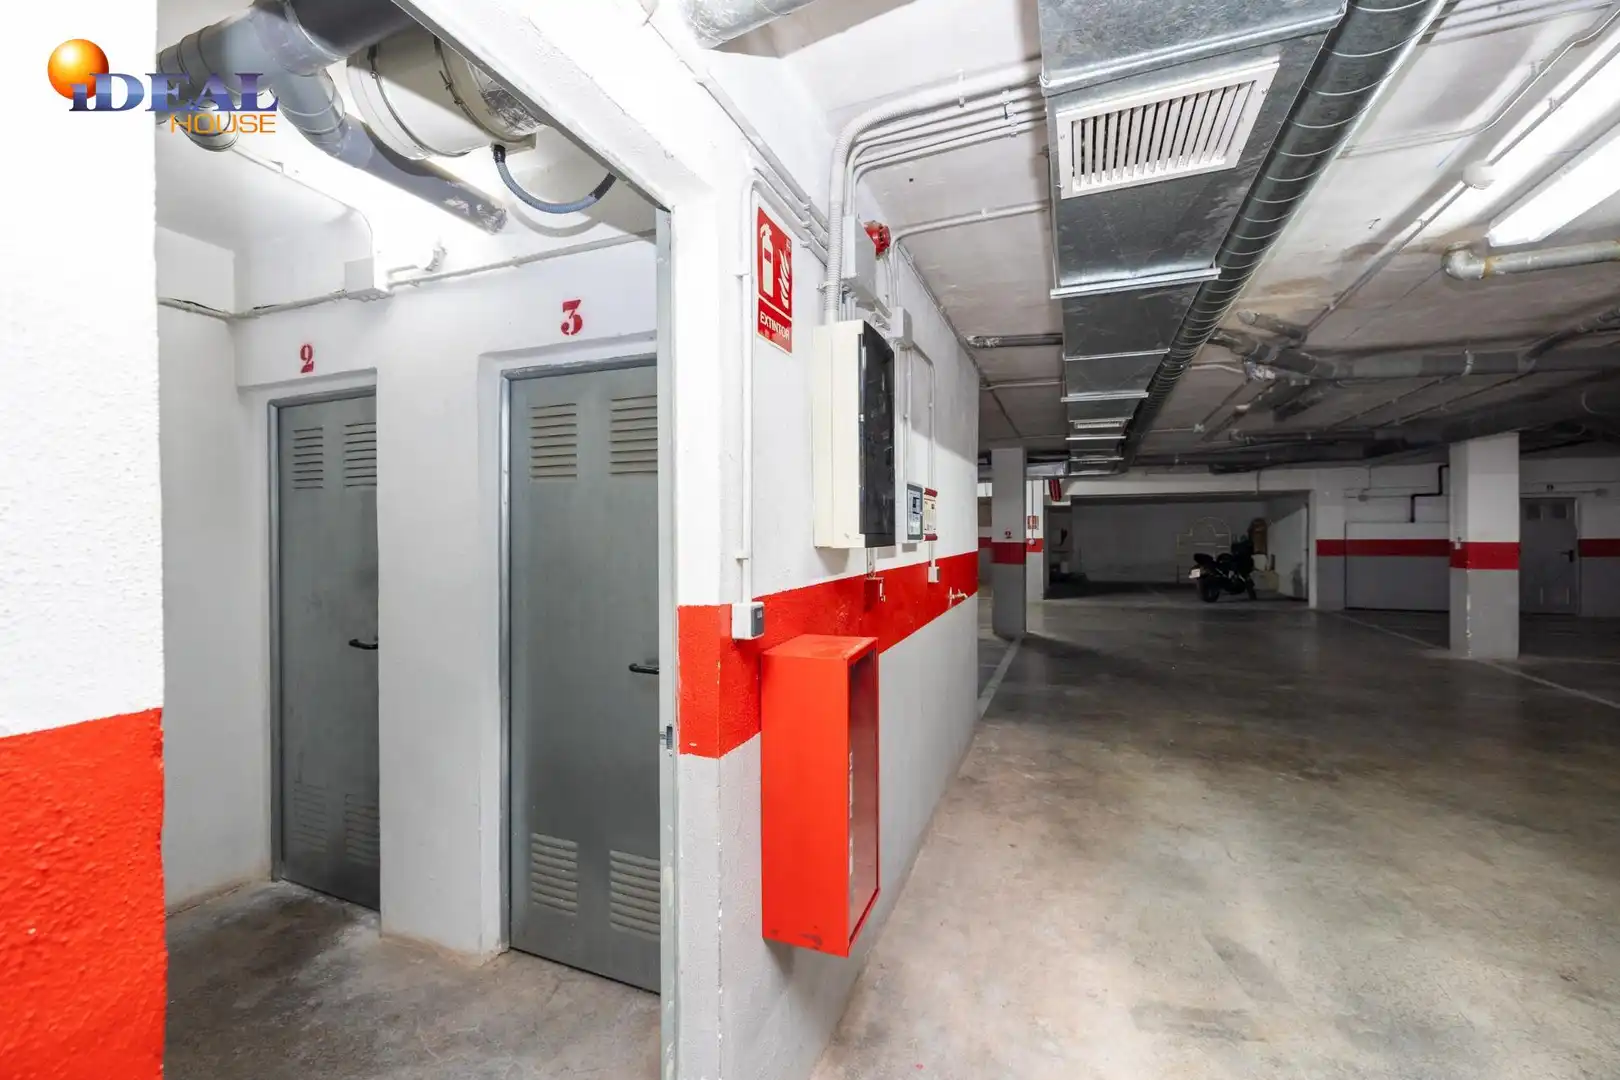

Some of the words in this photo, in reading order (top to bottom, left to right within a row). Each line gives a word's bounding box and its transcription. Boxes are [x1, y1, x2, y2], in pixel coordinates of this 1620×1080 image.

[560, 299, 583, 335] 3
[760, 310, 790, 341] EXTINTOR
[300, 344, 314, 373] 2
